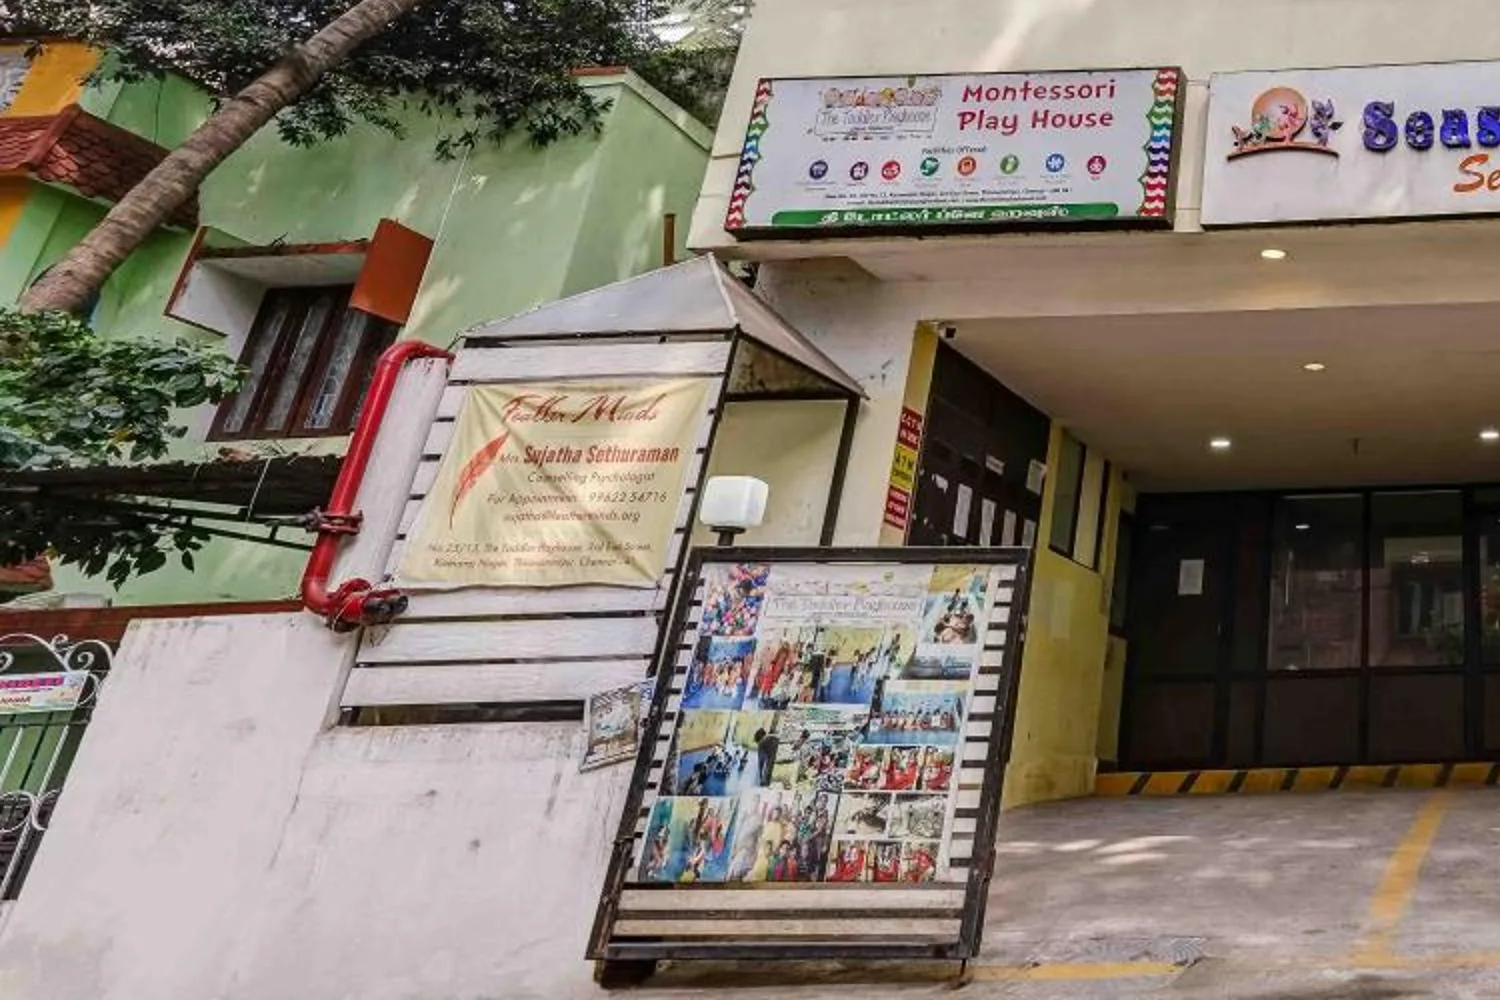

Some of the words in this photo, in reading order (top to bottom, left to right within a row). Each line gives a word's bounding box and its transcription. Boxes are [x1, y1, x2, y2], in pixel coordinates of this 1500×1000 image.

[961, 78, 1116, 103] Montessori
[957, 109, 1018, 136] Play
[1030, 109, 1114, 130] House
[523, 444, 582, 468] Sujatha
[586, 443, 680, 464] Sethuraman
